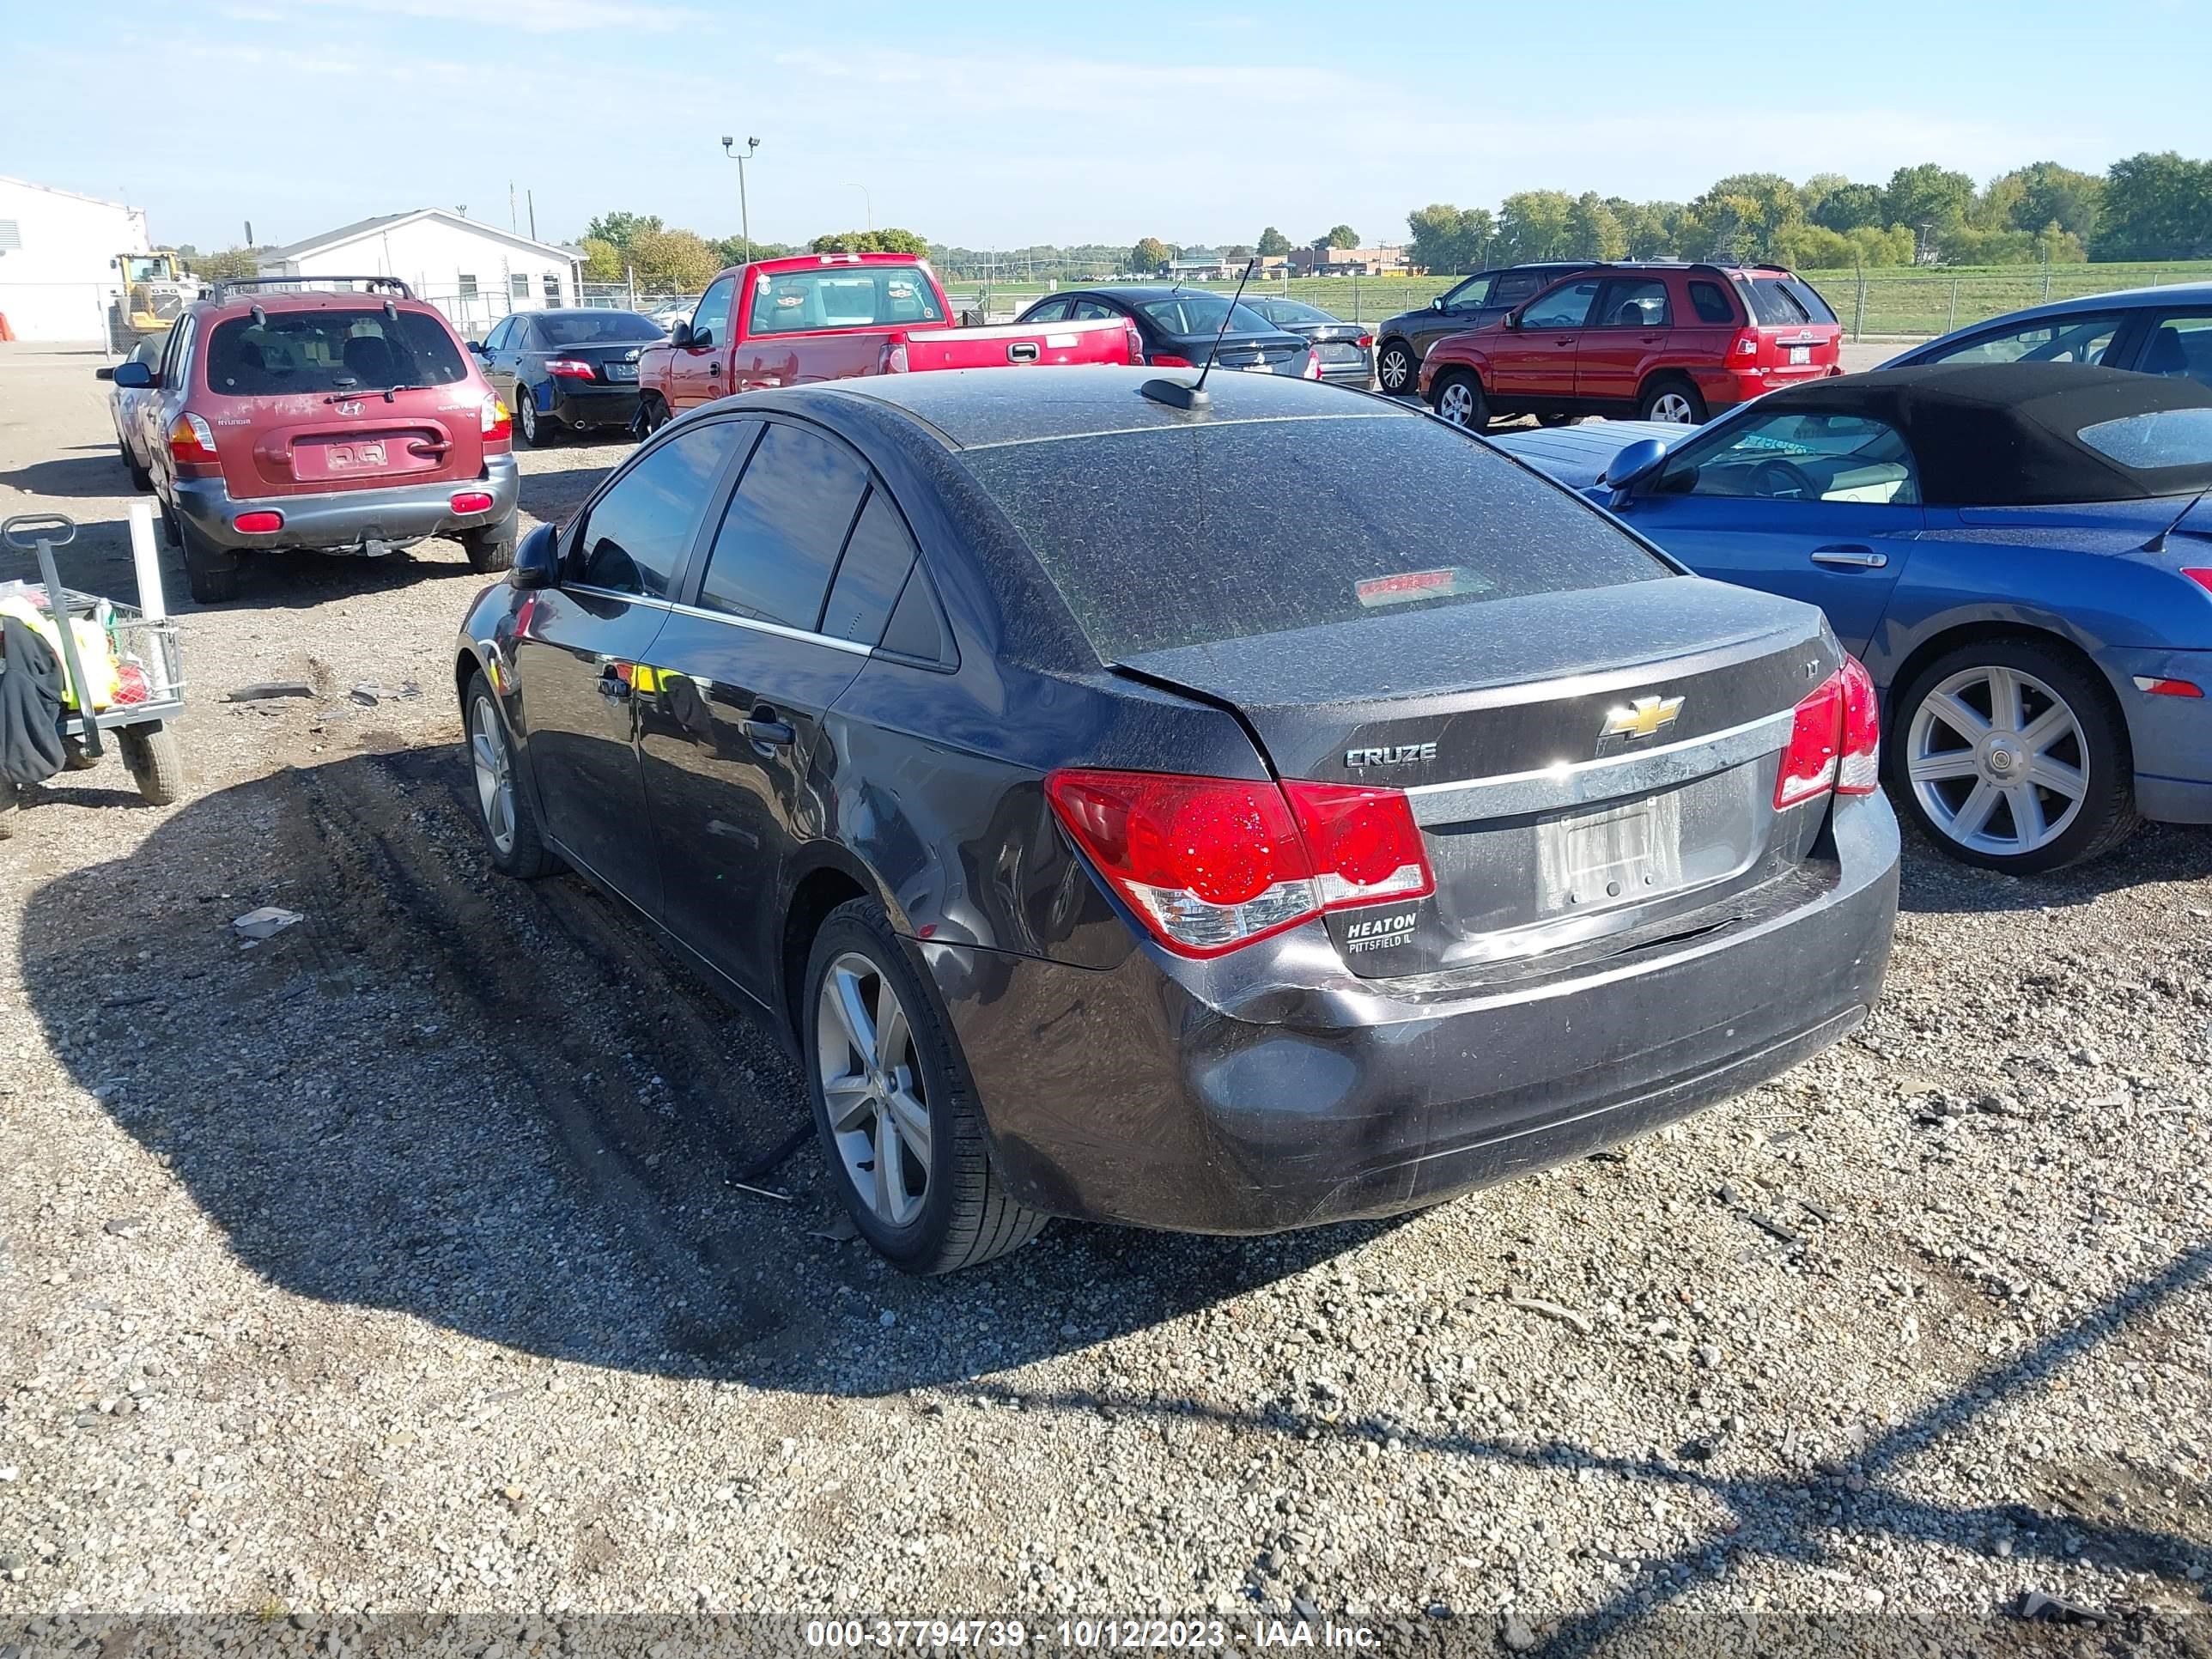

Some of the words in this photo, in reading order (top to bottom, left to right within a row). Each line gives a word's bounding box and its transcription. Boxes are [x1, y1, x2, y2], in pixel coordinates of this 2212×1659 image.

[1807, 659, 1820, 678] LT
[1344, 743, 1437, 768] CRUZE
[1348, 913, 1416, 938] HEATON
[1349, 936, 1401, 954] PITTSFIELD
[1404, 933, 1412, 944] IL
